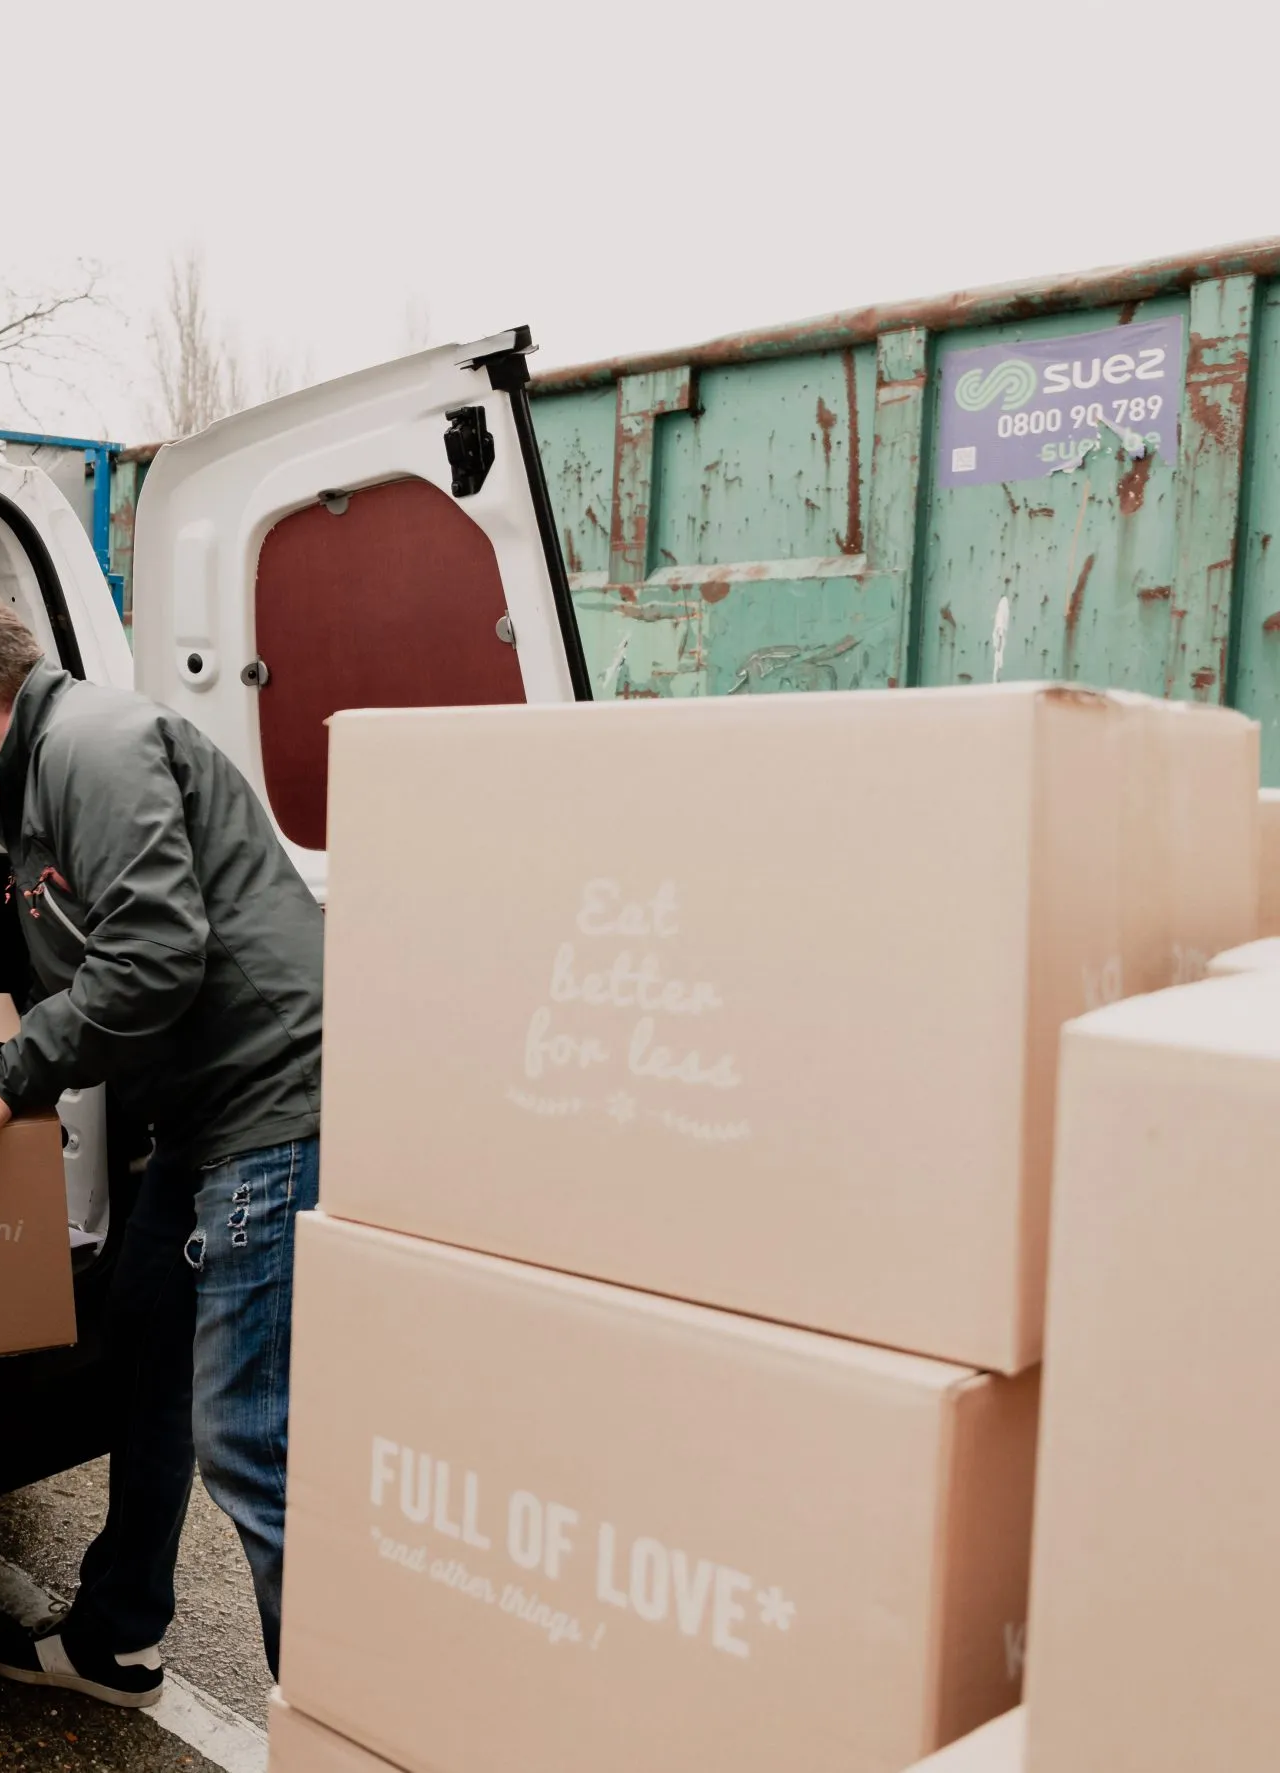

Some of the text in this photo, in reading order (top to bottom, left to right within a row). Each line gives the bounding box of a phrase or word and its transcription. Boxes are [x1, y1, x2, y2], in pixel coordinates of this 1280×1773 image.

[1042, 347, 1165, 394] suez
[997, 395, 1163, 438] 0800 90 789
[576, 877, 680, 938] Eat
[550, 942, 724, 1015] better
[524, 1005, 742, 1090] for less
[370, 1435, 491, 1550] FULL
[507, 1489, 579, 1580] OF
[429, 1557, 497, 1604] other
